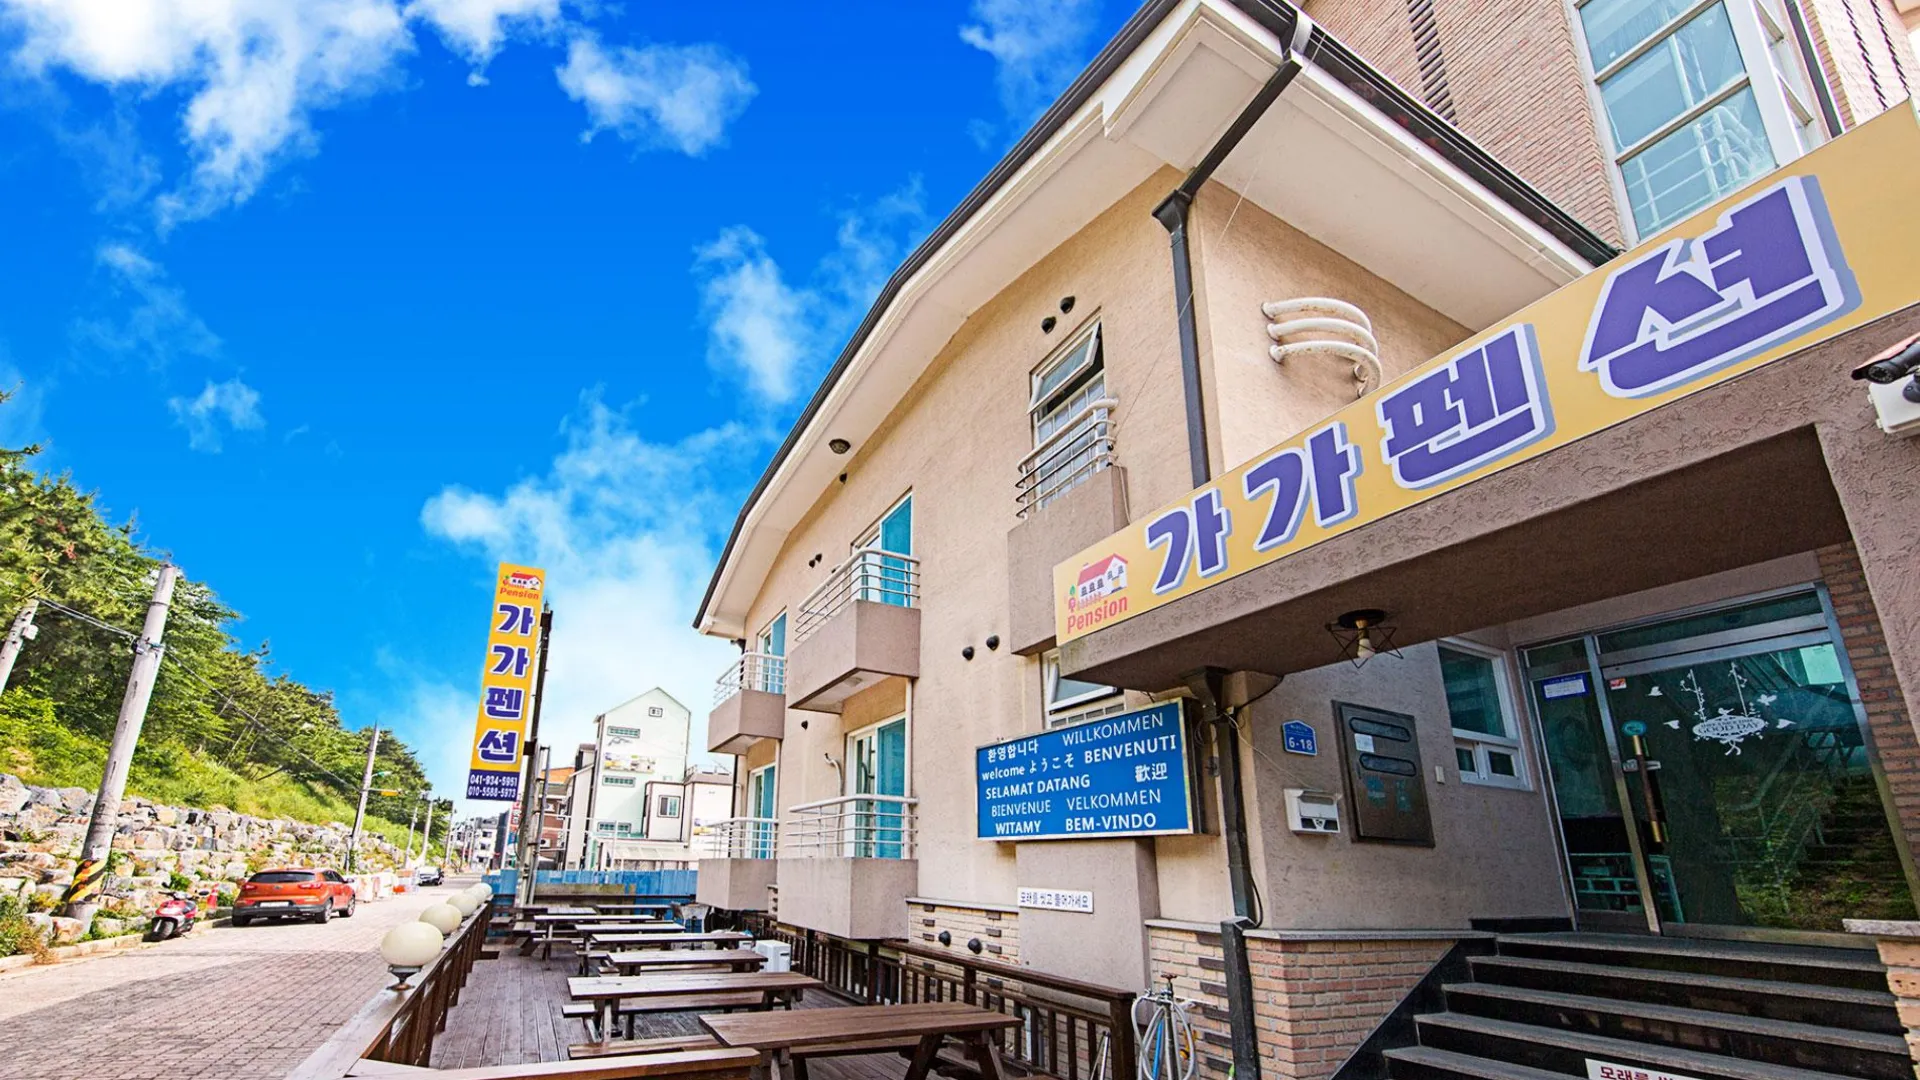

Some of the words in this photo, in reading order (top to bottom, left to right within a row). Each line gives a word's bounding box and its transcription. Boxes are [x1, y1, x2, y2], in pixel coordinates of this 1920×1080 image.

[1146, 182, 1848, 593] 가가펜션
[500, 587, 539, 600] Pension
[1067, 596, 1128, 634] Pension
[478, 603, 535, 762] 가가펜션
[988, 739, 1039, 763] 환영합니다
[1062, 712, 1164, 746] WILLKOMMEN
[1288, 737, 1313, 750] 6-18
[982, 765, 1025, 781] welcome
[1029, 753, 1075, 773] ようこそ
[1085, 735, 1177, 764] BENVENUTI
[986, 781, 1034, 800] SELAMAT
[1037, 774, 1091, 793] DATANG
[1134, 762, 1168, 783] 歡迎
[991, 799, 1052, 817] BIENVENUE
[1067, 788, 1161, 811] VELKOMMEN
[995, 820, 1041, 835] WITAMY
[1065, 813, 1157, 831] BEM-VINDO
